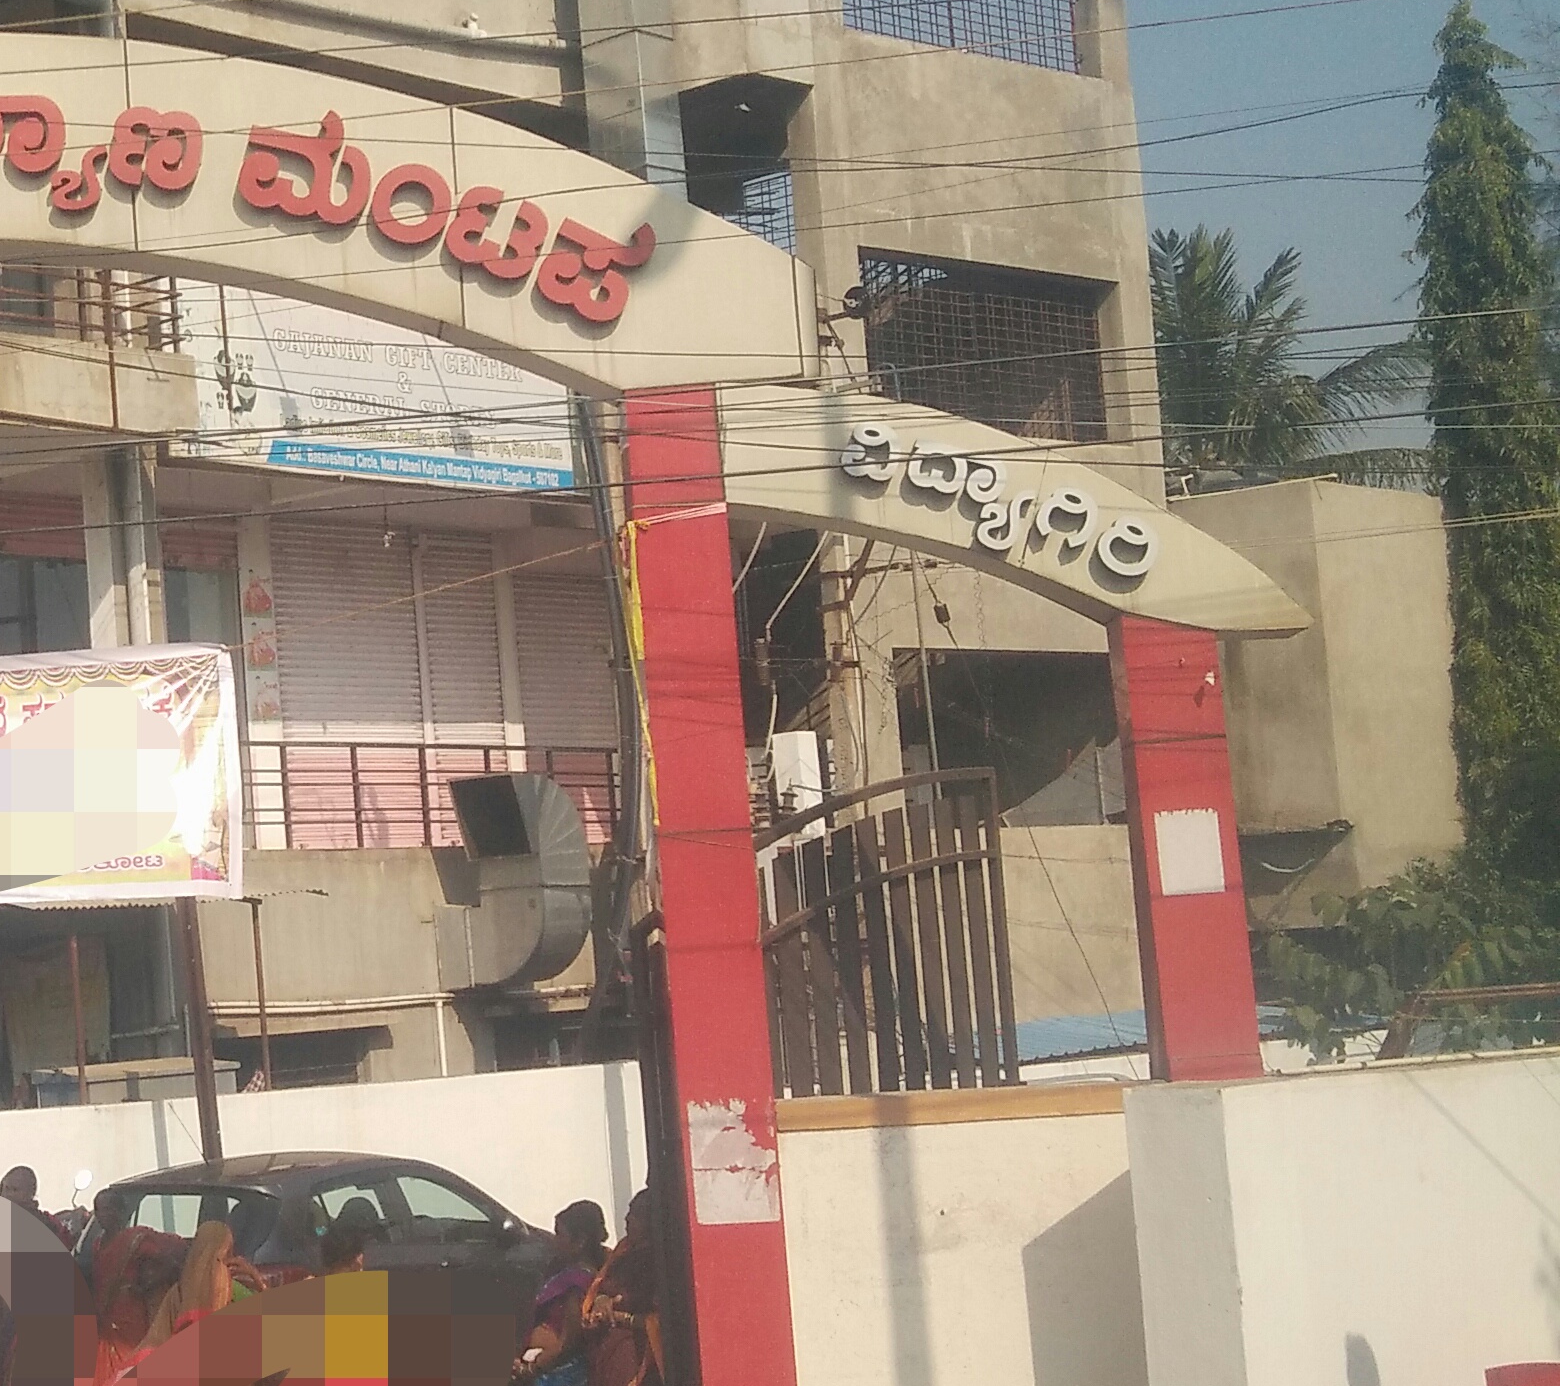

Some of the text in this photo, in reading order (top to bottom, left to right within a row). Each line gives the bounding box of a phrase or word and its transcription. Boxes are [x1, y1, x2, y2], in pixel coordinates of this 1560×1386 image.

[240, 109, 656, 323] ಮಂಟಪ
[272, 328, 523, 383] GAJANAN GIFT CENTER
[311, 387, 409, 417] GENERAL
[397, 372, 413, 393] &
[380, 456, 397, 471] Near
[422, 459, 446, 478] Kalyan
[840, 422, 1159, 578] ವಿದ್ಯಾಗಿರಿ
